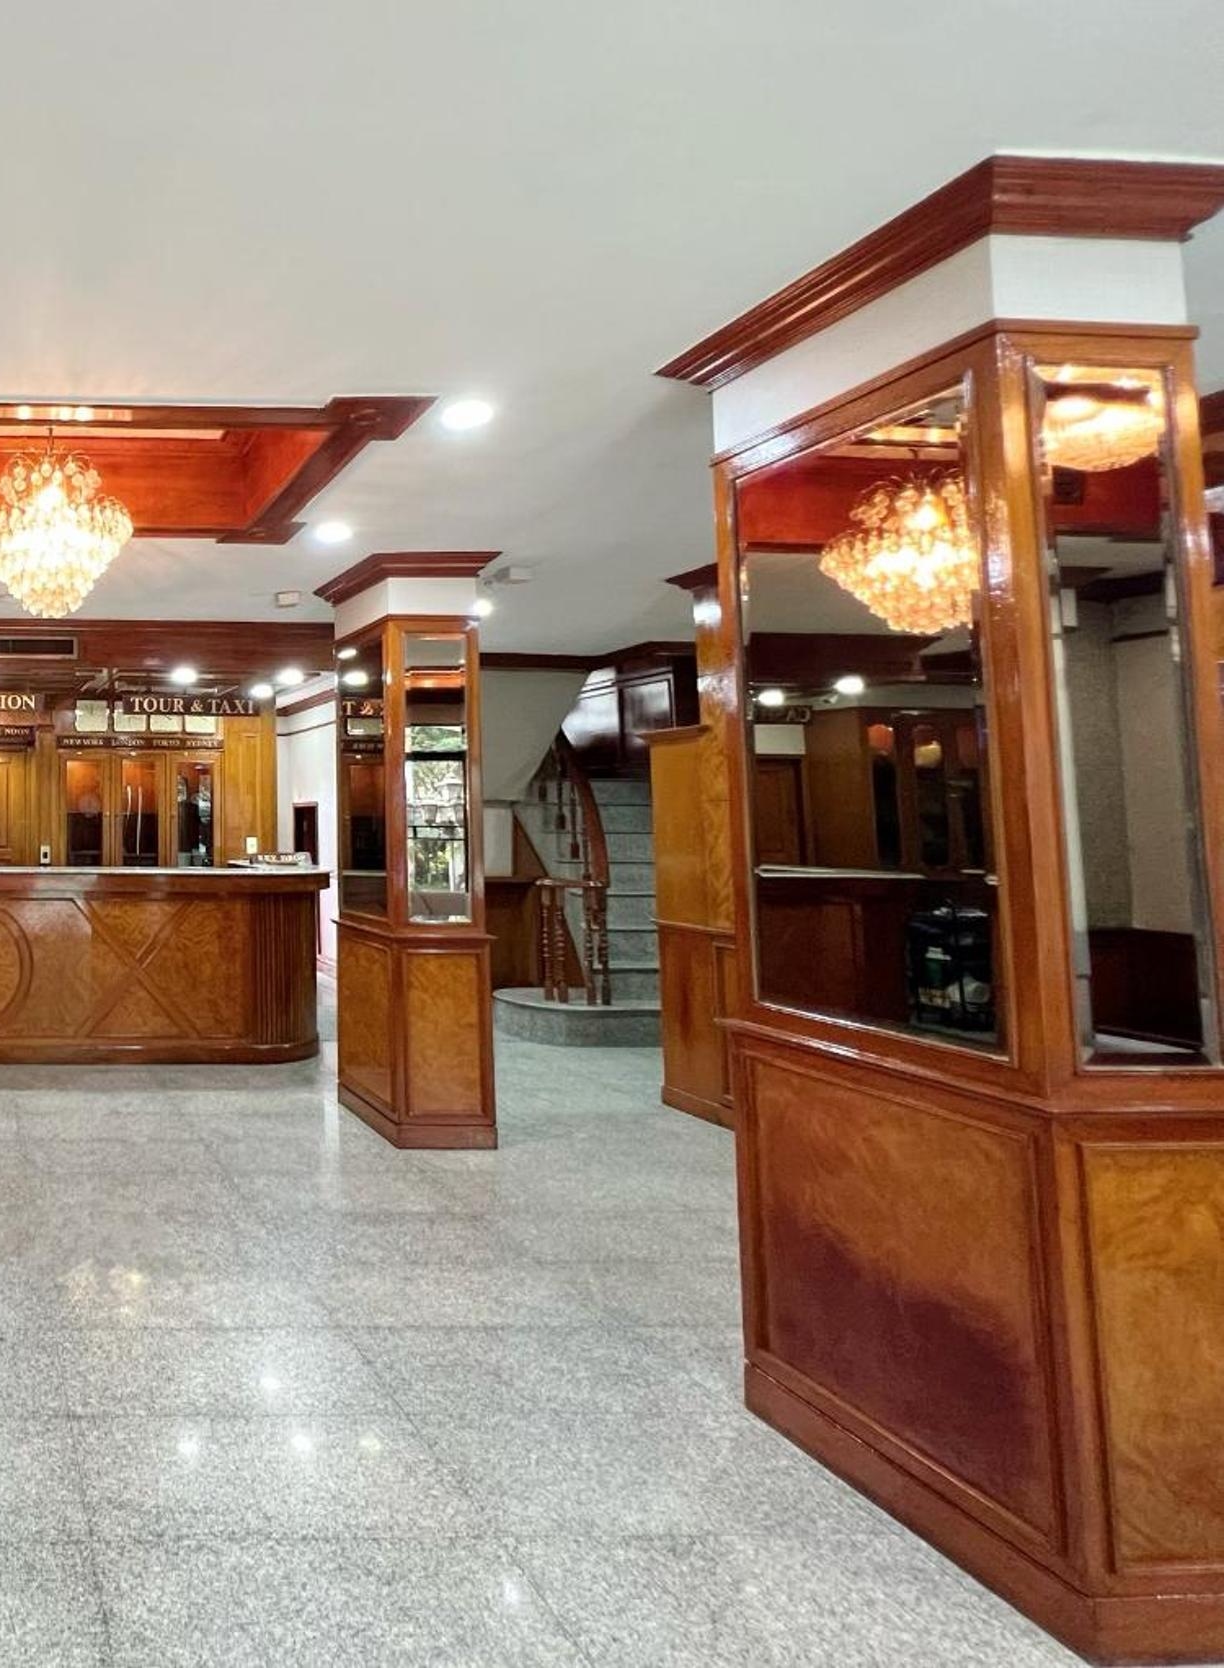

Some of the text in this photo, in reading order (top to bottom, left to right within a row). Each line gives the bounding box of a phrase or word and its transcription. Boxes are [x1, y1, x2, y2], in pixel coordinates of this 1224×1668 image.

[130, 697, 254, 714] TOUR & TAXI
[4, 728, 30, 736] NOON
[111, 738, 146, 747] LONDON
